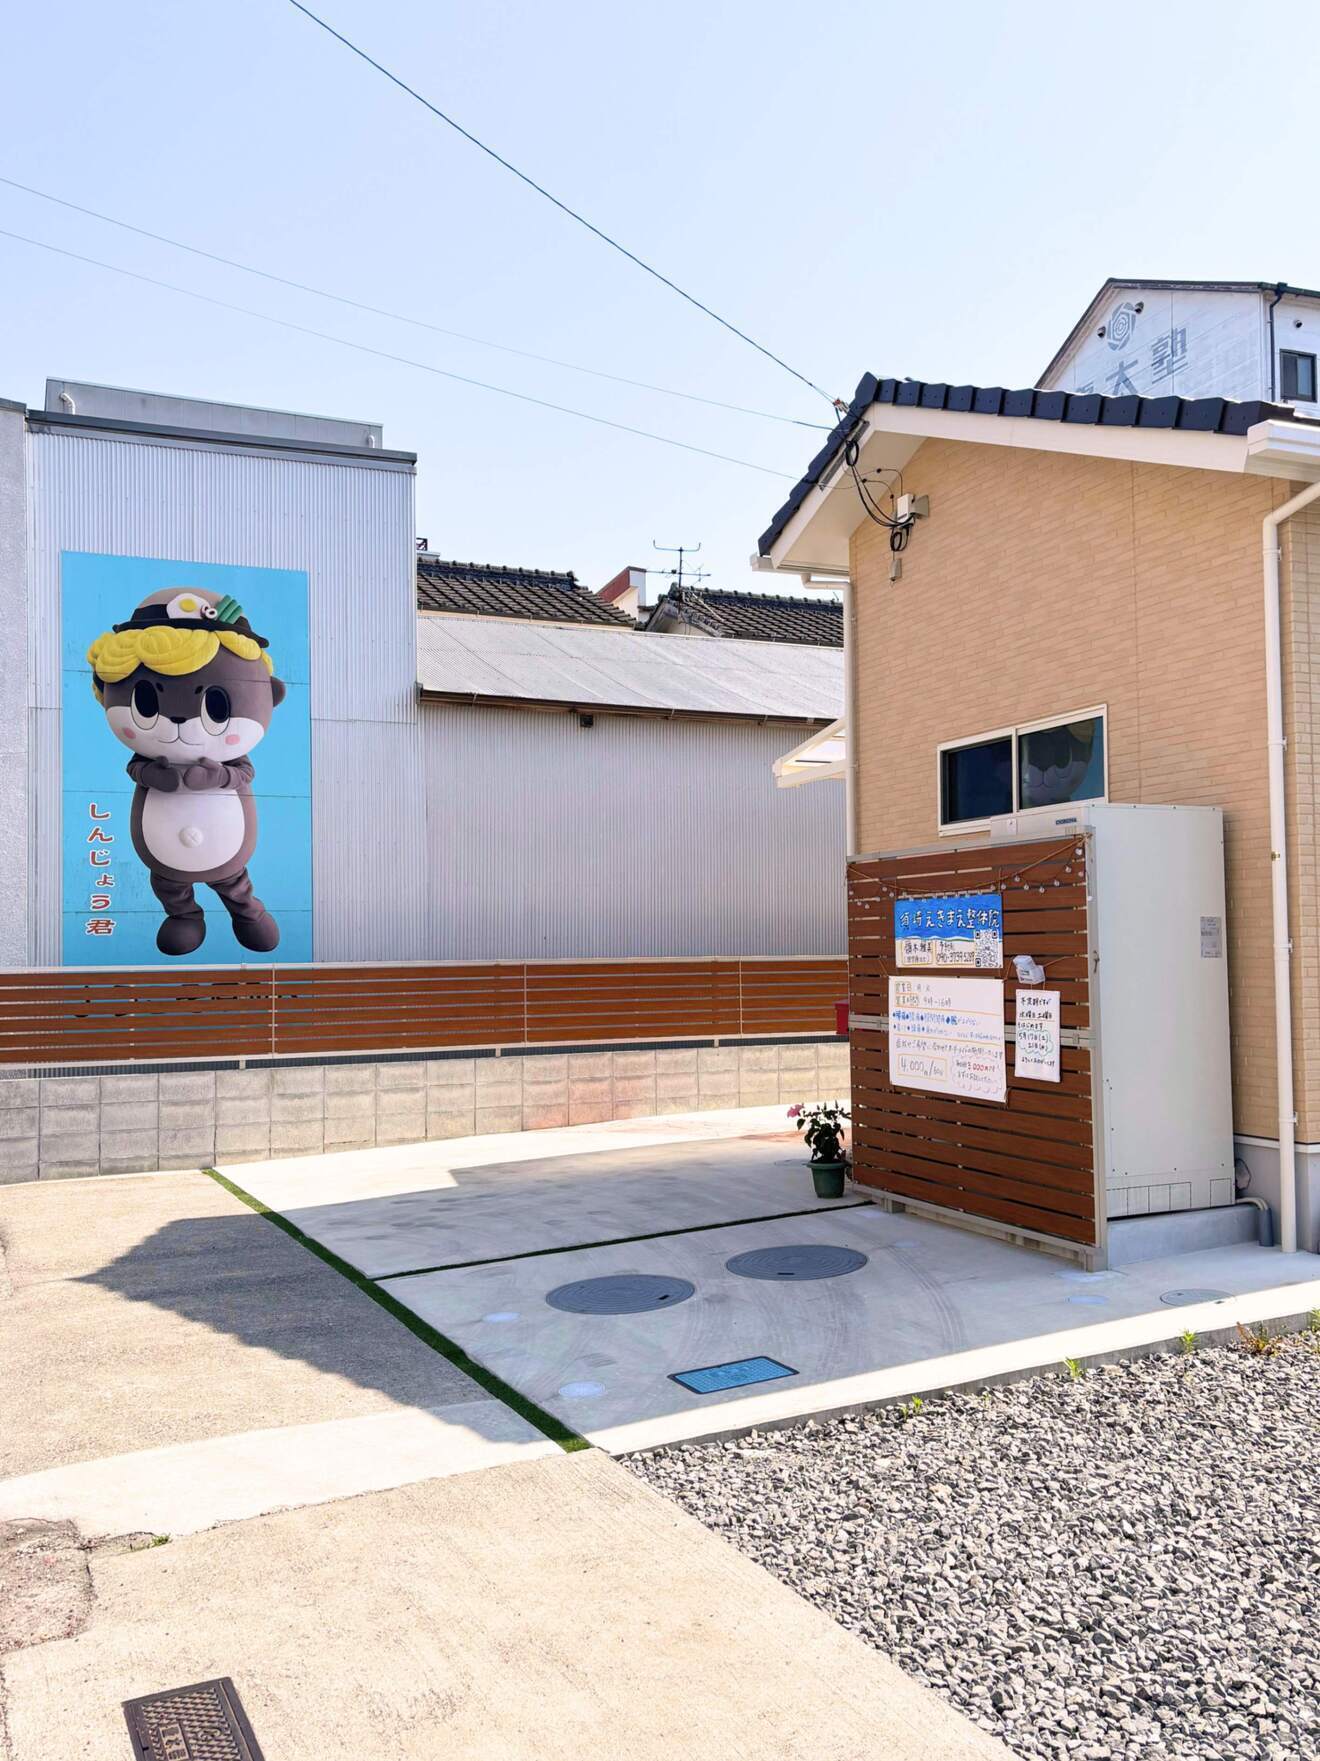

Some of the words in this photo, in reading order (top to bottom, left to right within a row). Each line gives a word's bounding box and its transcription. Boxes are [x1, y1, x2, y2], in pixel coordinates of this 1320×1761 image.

[86, 801, 116, 936] しんじょう君
